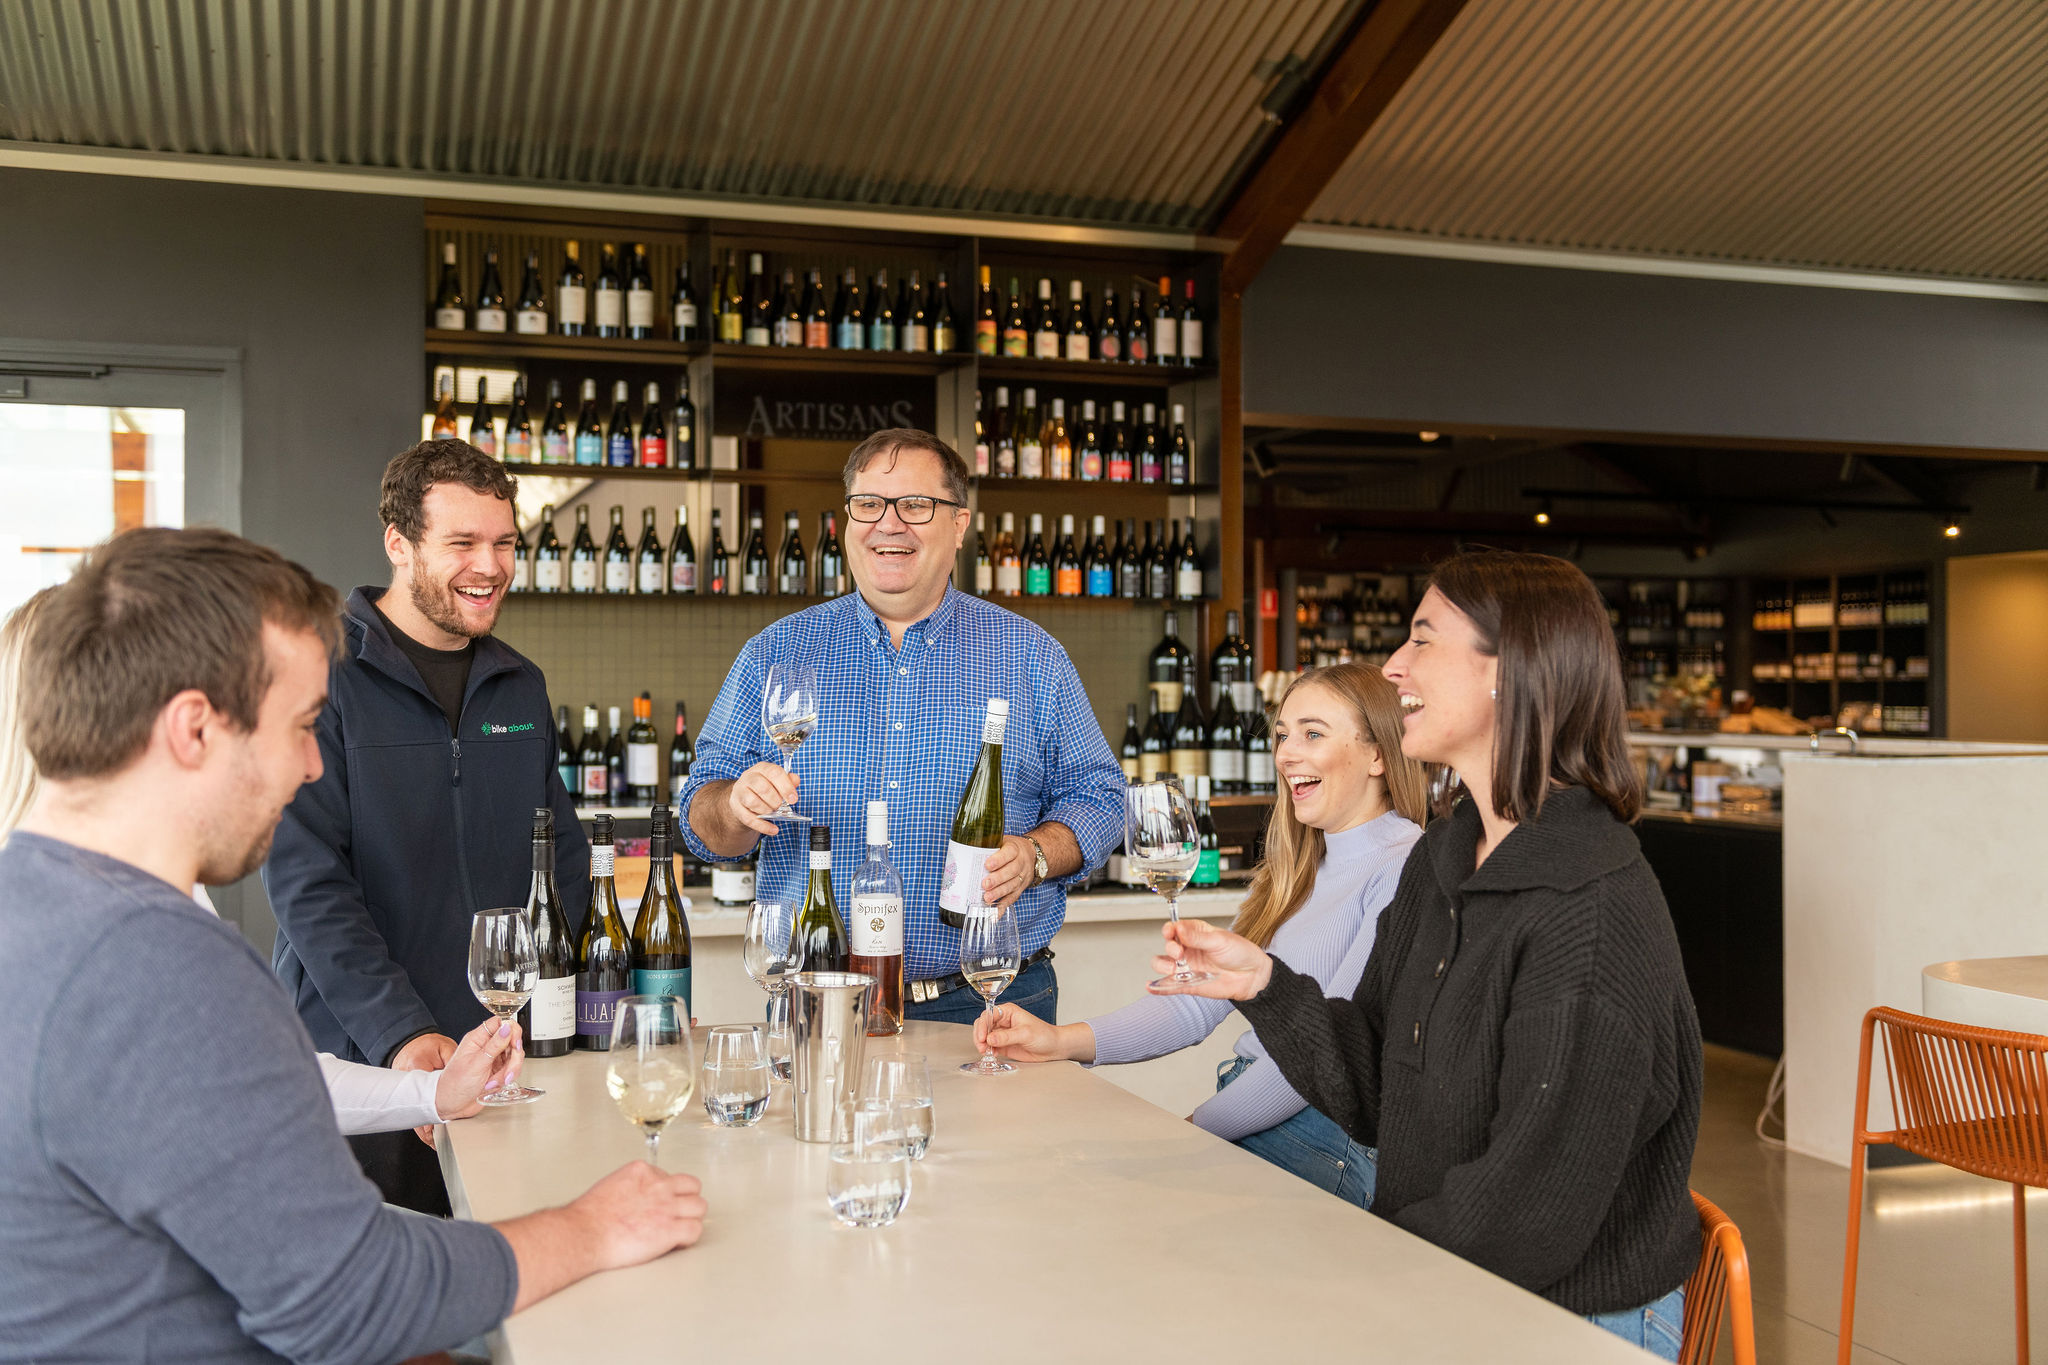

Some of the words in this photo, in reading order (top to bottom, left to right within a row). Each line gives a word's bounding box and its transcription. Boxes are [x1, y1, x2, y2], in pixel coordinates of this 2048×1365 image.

[745, 395, 914, 437] ARTISANS
[491, 724, 507, 734] bike
[507, 722, 535, 733] about
[857, 902, 898, 917] Spinifex
[577, 1002, 617, 1021] LIJAH
